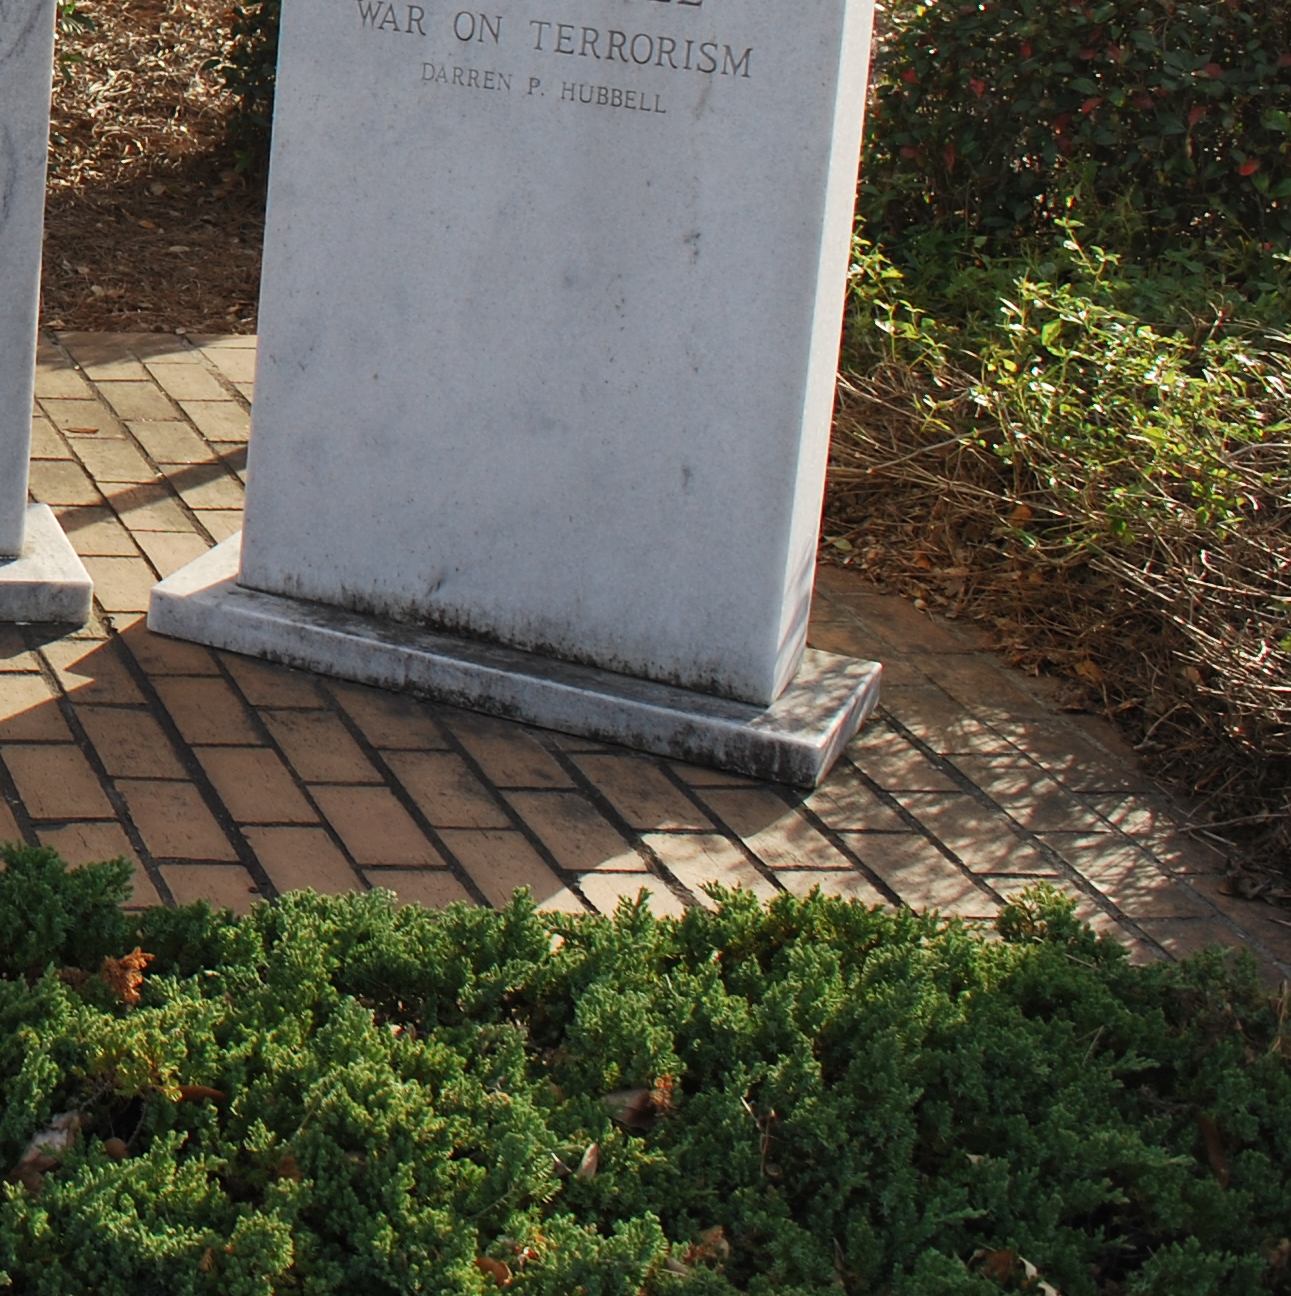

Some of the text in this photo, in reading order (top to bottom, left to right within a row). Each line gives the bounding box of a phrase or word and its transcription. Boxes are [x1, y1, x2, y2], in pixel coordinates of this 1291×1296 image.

[453, 10, 503, 45] ON
[529, 20, 754, 78] TERRORISM
[421, 63, 667, 115] DARREN P. HUBBELL
